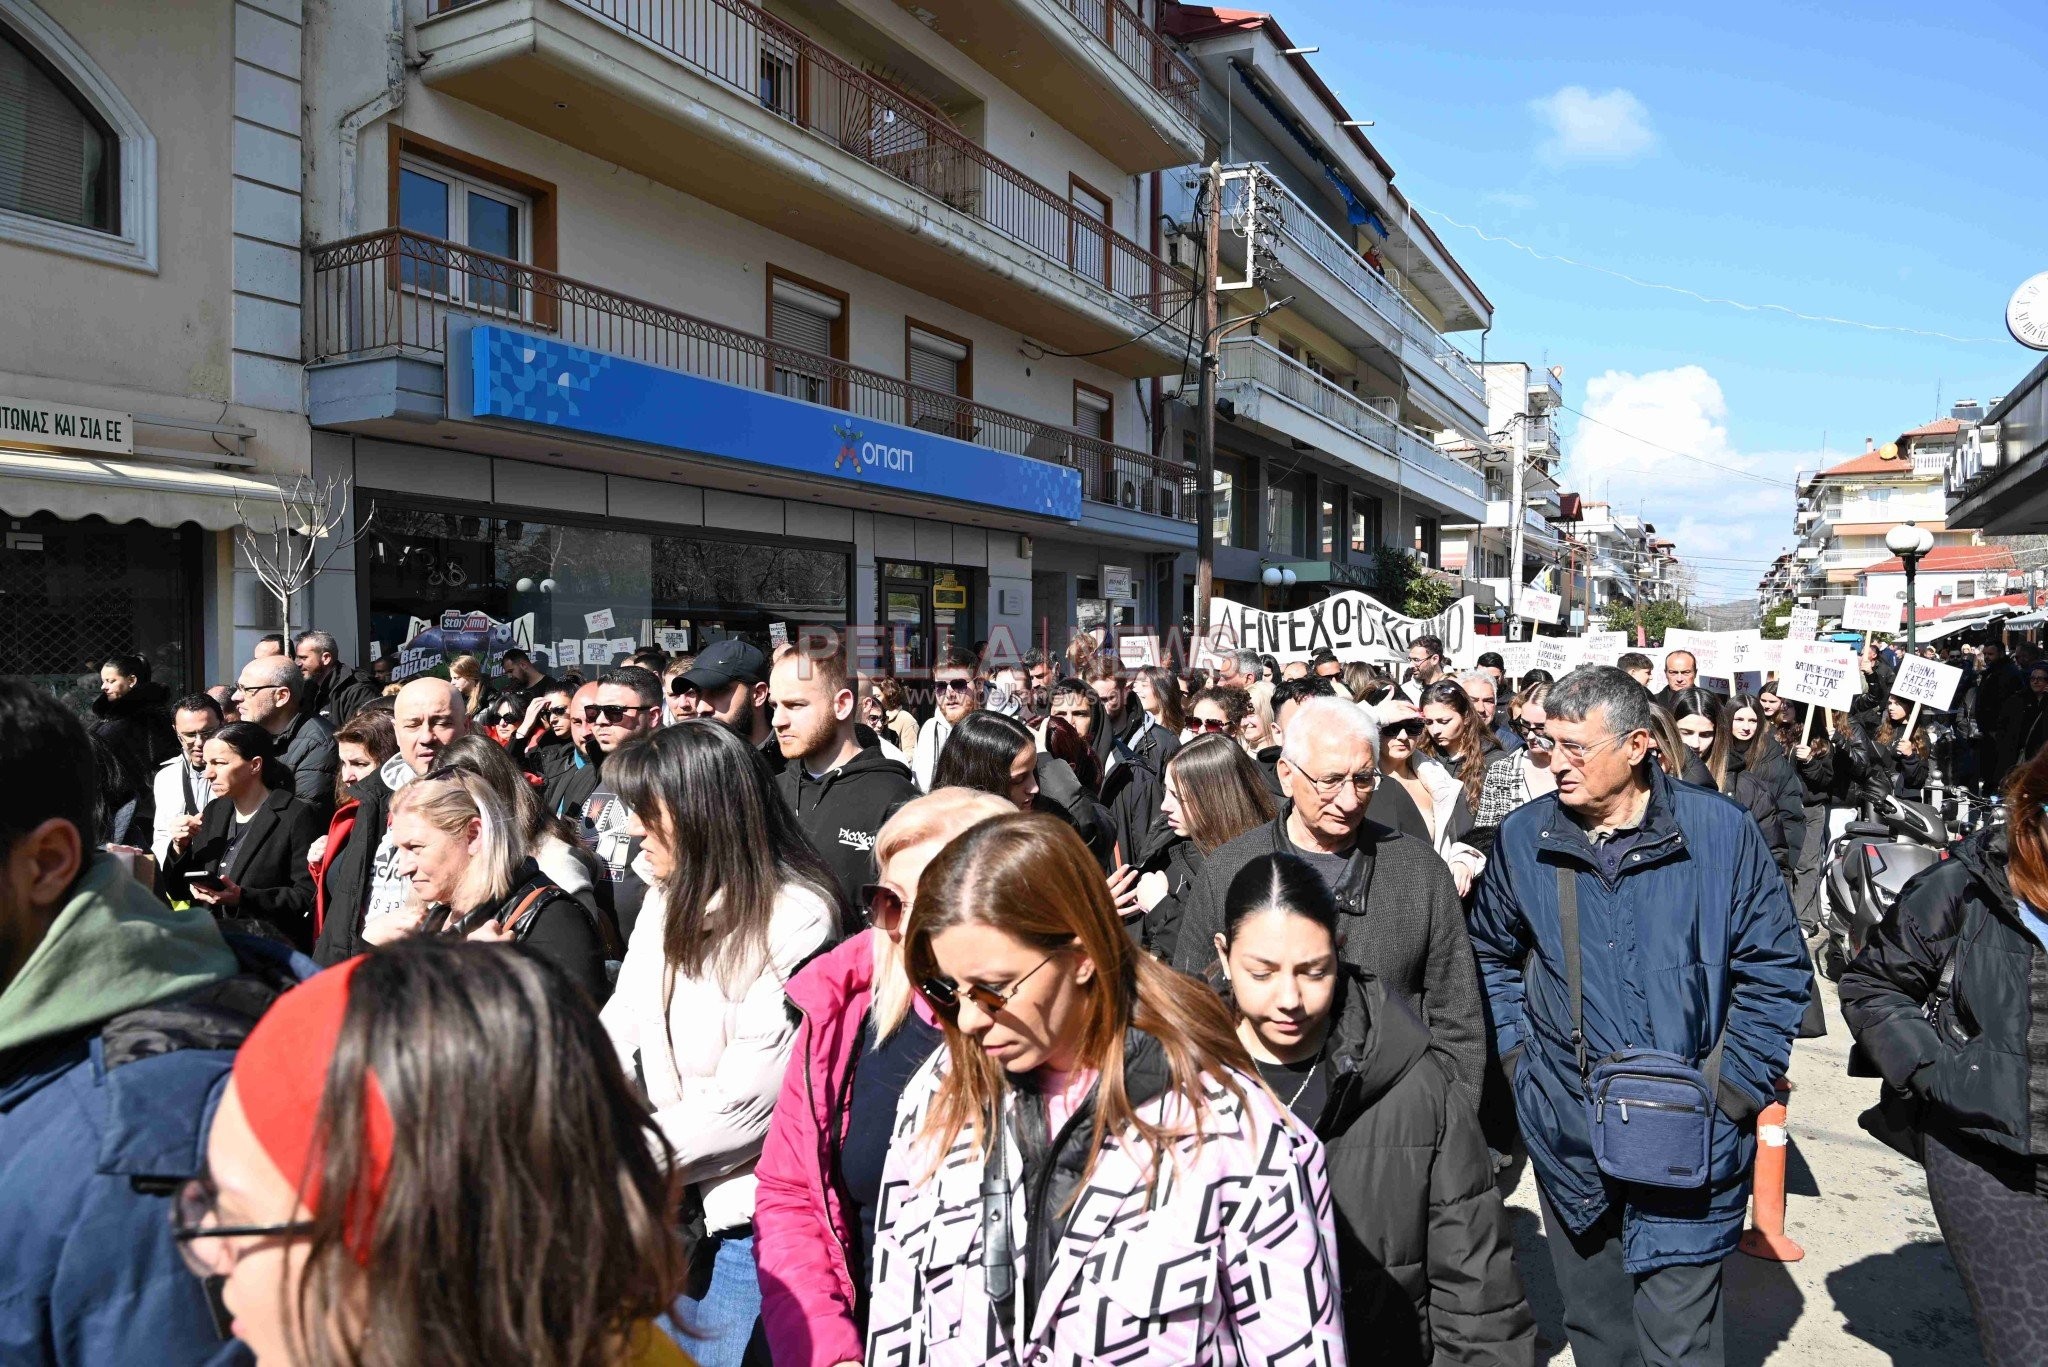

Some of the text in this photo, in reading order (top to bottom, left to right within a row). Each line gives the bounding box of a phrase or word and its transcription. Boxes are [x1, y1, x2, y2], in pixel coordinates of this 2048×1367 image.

[0, 406, 122, 443] ΤΩΝΑΣ ΚΑΙ ΣΙΑ ΕΕ
[401, 648, 426, 664] BET
[1907, 662, 1936, 678] ΑΘΗΝΑ
[1903, 672, 1939, 690] ΚΑΤΣΑΡΑ
[1819, 688, 1830, 699] 52
[1899, 682, 1935, 700] ΕΤΩΝ 34
